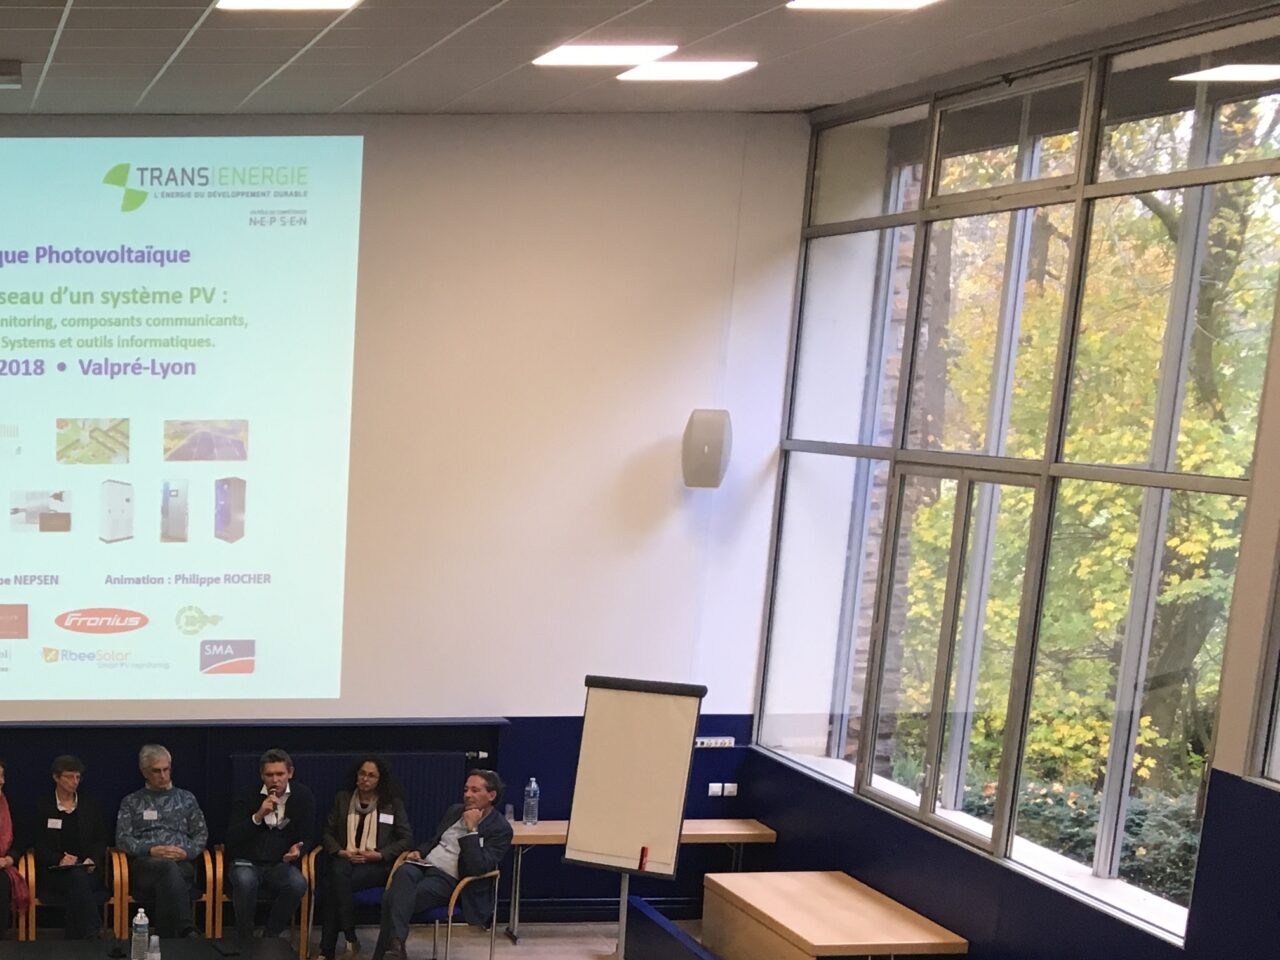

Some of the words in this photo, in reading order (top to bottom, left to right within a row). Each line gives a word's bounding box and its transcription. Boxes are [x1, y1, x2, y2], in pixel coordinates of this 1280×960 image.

[35, 245, 191, 268] Photovoltaïque
[50, 286, 95, 304] d'un
[100, 286, 183, 308] système
[189, 287, 216, 304] PV
[61, 316, 142, 330] composants
[145, 314, 249, 329] communicants,
[1, 336, 56, 351] Systems
[59, 337, 72, 349] et
[76, 335, 113, 349] outils
[117, 335, 216, 351] informatiques.
[78, 357, 197, 380] Valpré-Lyon
[14, 574, 59, 585] NEPSEN
[105, 574, 165, 585] Animation
[174, 573, 221, 587] Philippe
[223, 573, 271, 585] ROCHER
[64, 609, 142, 627] Fronius
[204, 644, 234, 655] SMA
